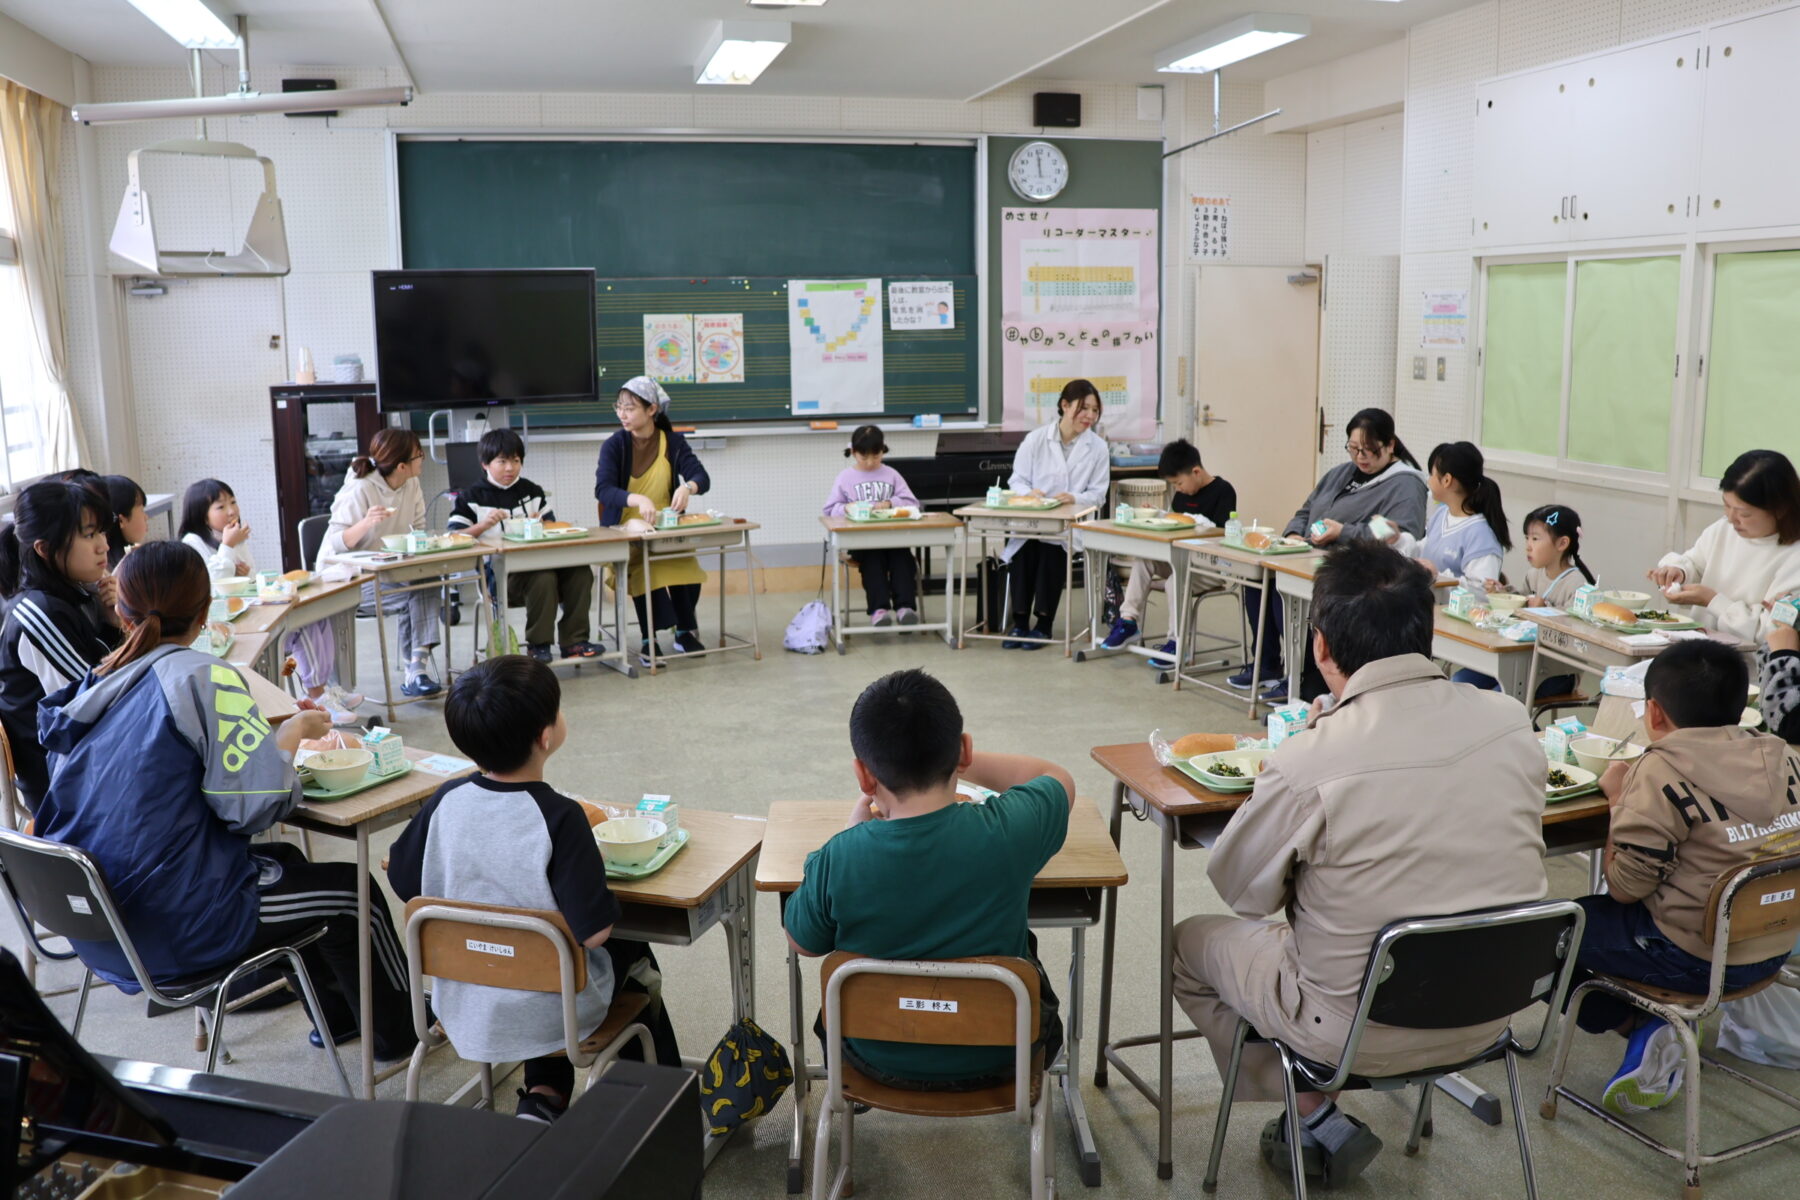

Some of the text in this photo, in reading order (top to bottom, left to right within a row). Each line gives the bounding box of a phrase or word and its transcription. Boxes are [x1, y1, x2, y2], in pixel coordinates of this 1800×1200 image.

[468, 942, 487, 951] にいやま
[905, 1000, 925, 1009] 三影
